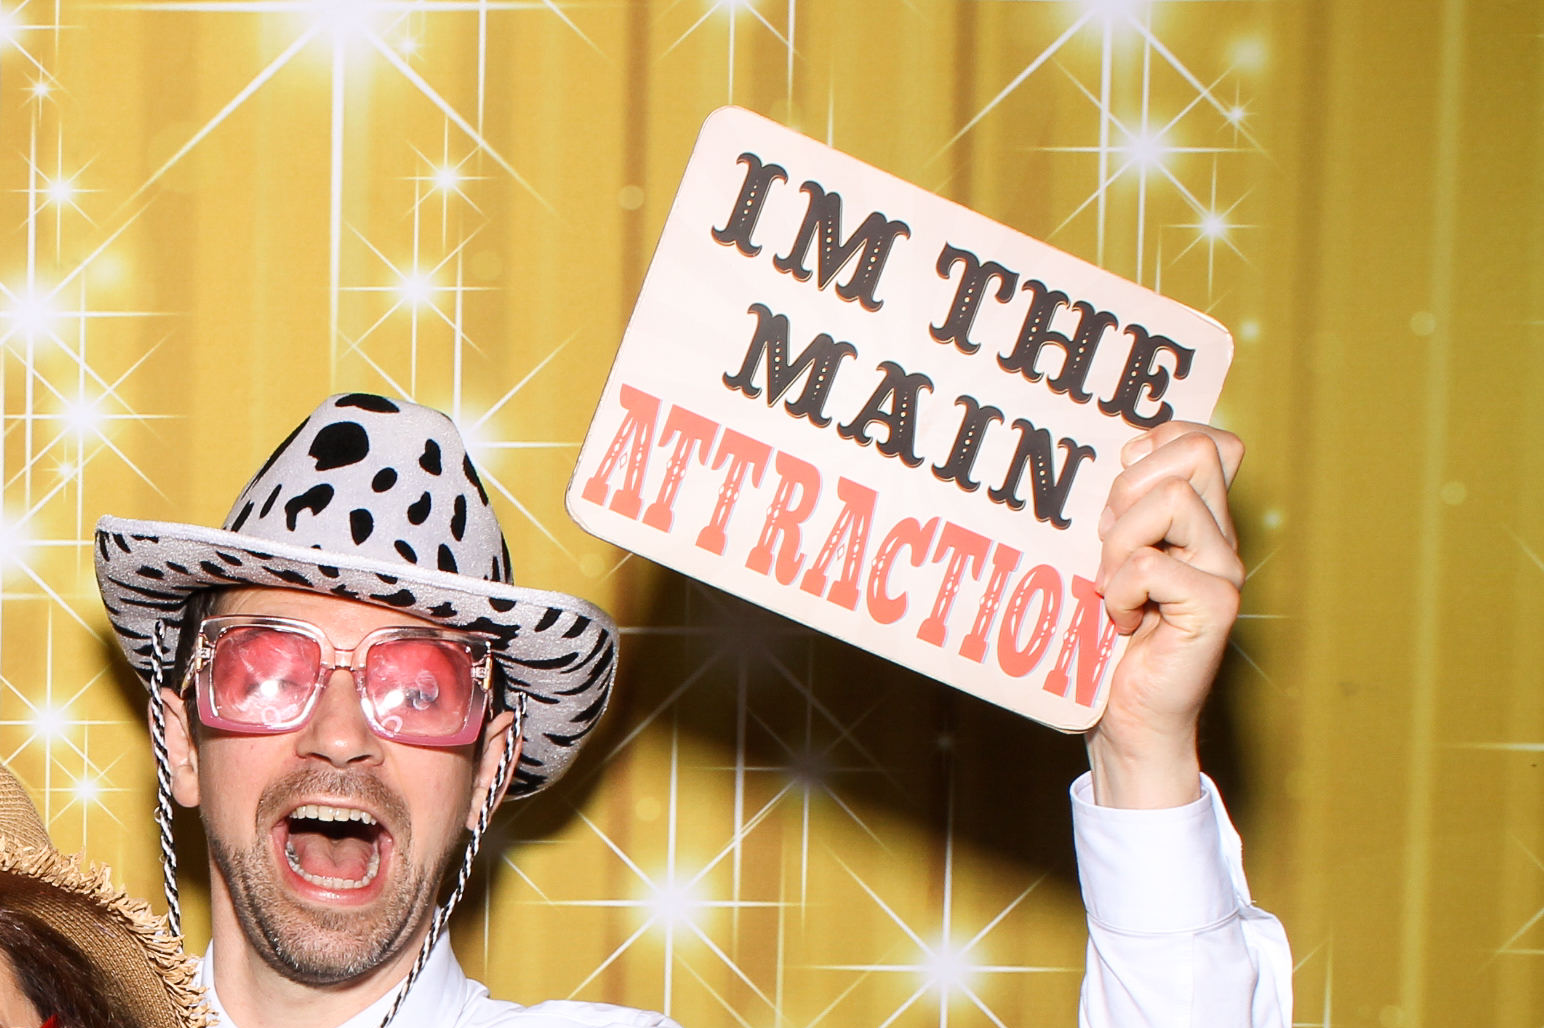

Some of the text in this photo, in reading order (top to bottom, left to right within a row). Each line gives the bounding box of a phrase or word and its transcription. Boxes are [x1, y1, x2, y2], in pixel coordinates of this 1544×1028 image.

[711, 152, 1196, 430] IM THE
[722, 303, 1097, 530] MAIN
[581, 383, 1118, 708] ATTRACTION
